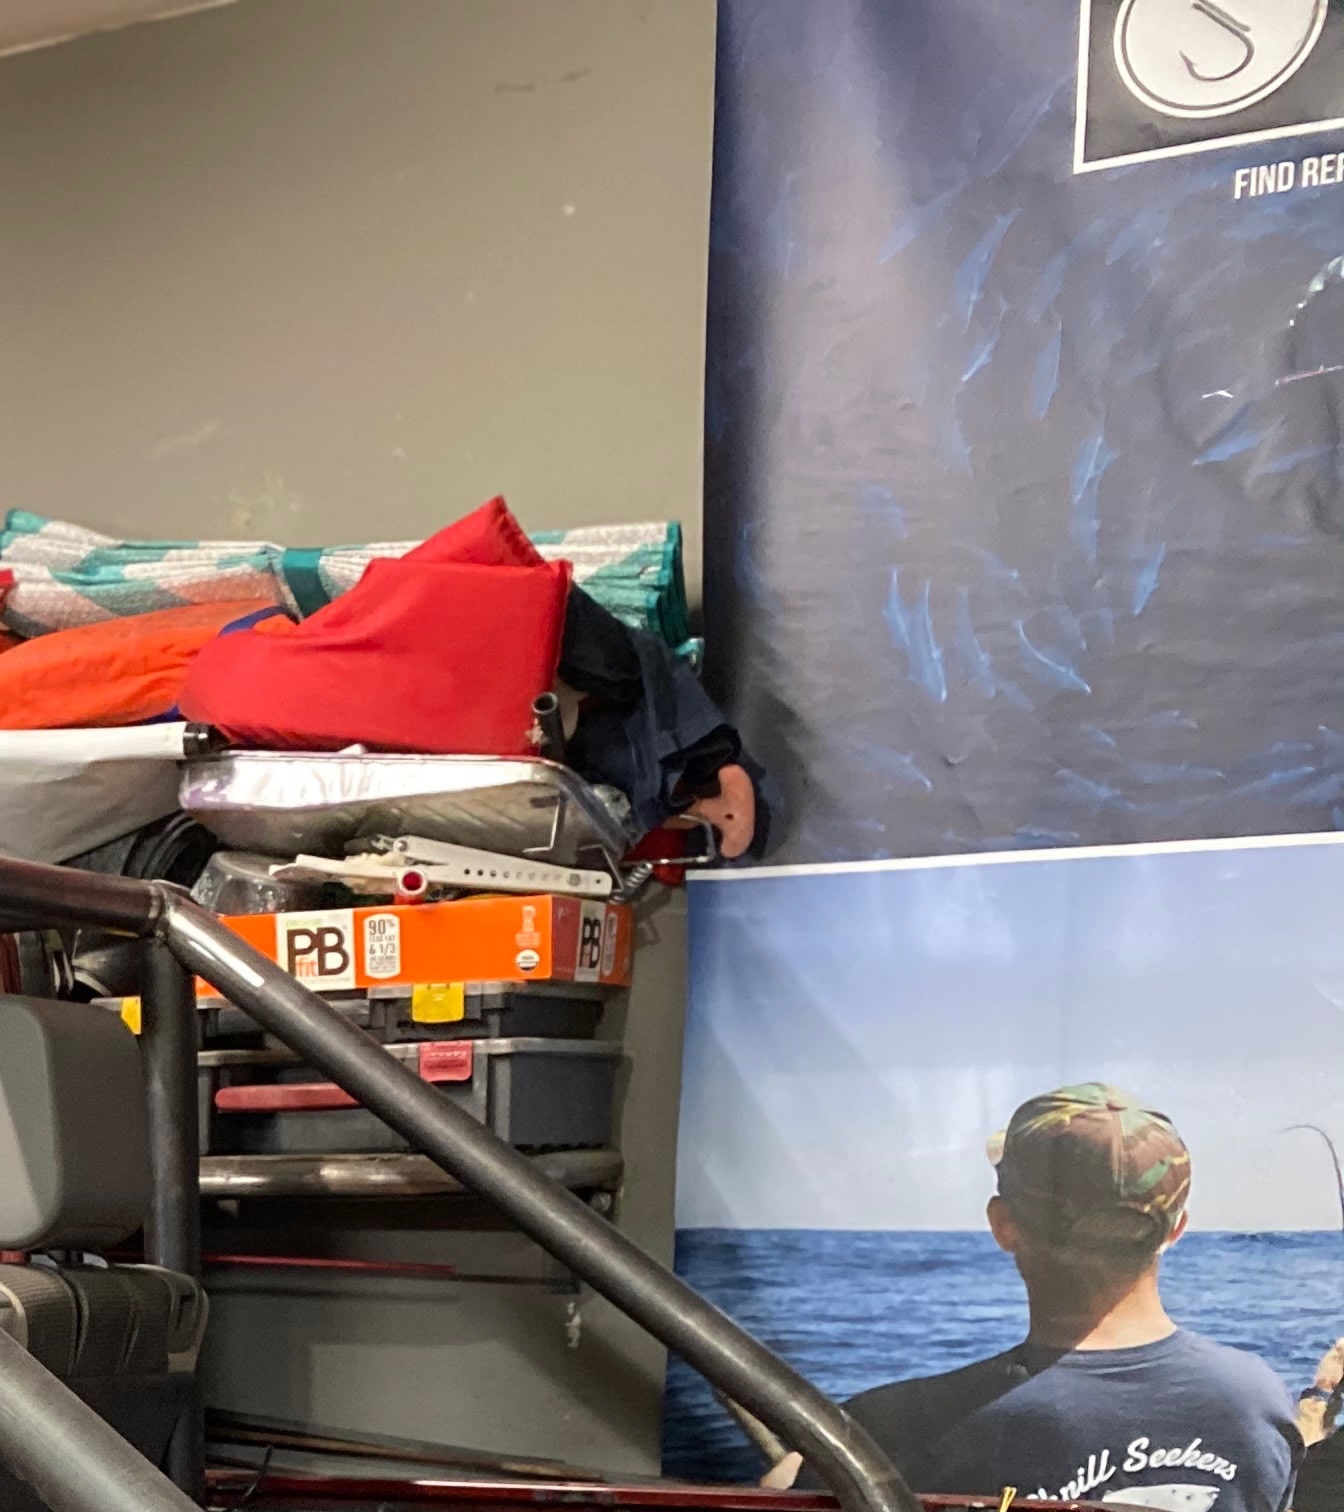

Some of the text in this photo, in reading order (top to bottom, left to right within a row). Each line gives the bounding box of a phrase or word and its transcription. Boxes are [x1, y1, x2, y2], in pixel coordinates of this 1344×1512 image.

[1234, 161, 1295, 200] FIND
[287, 926, 350, 977] PB
[1026, 1437, 1237, 1500] rill Seekers
